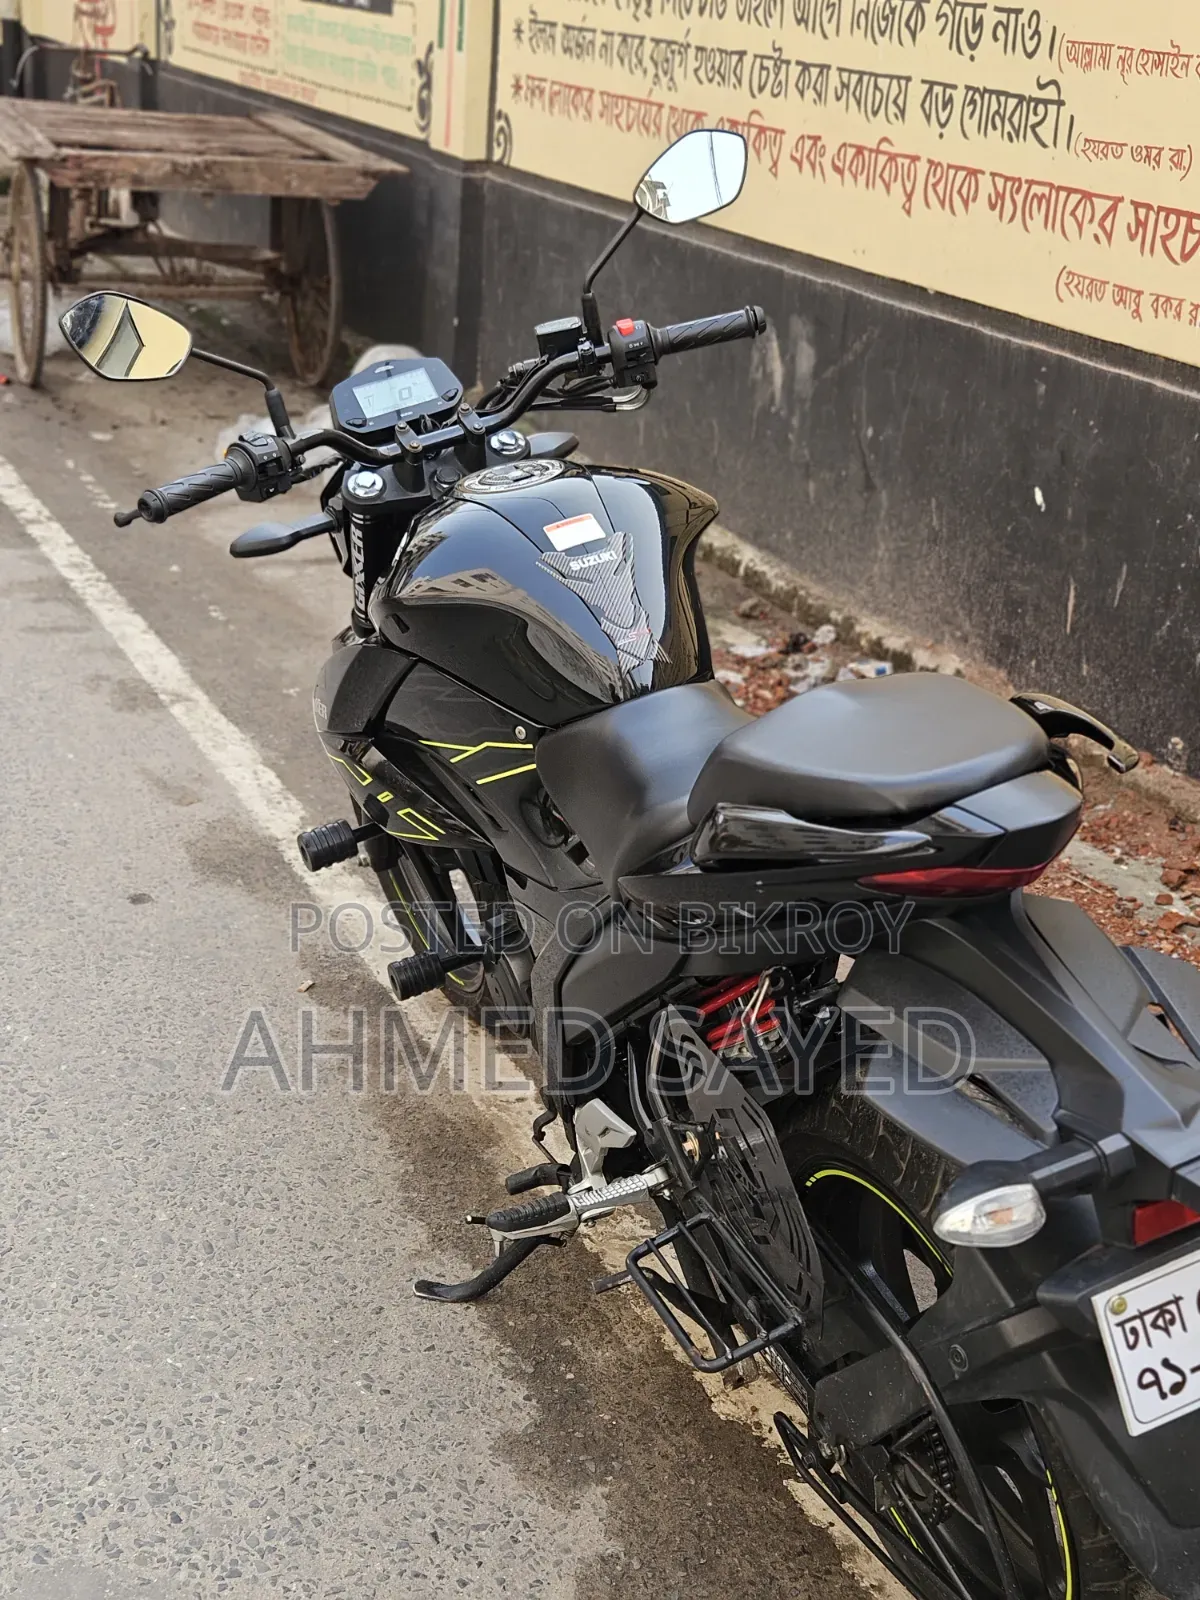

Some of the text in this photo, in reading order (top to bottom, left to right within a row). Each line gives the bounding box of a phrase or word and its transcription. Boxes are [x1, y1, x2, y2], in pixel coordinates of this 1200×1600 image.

[749, 40, 792, 99] চেষ্টা
[795, 59, 832, 108] করা
[789, 133, 827, 184] এবং
[923, 157, 985, 217] থেকে
[1112, 283, 1145, 323] আবু
[1148, 292, 1187, 322] বকর
[569, 550, 617, 572] SUZUKI
[1114, 1293, 1189, 1351] ঢাকা
